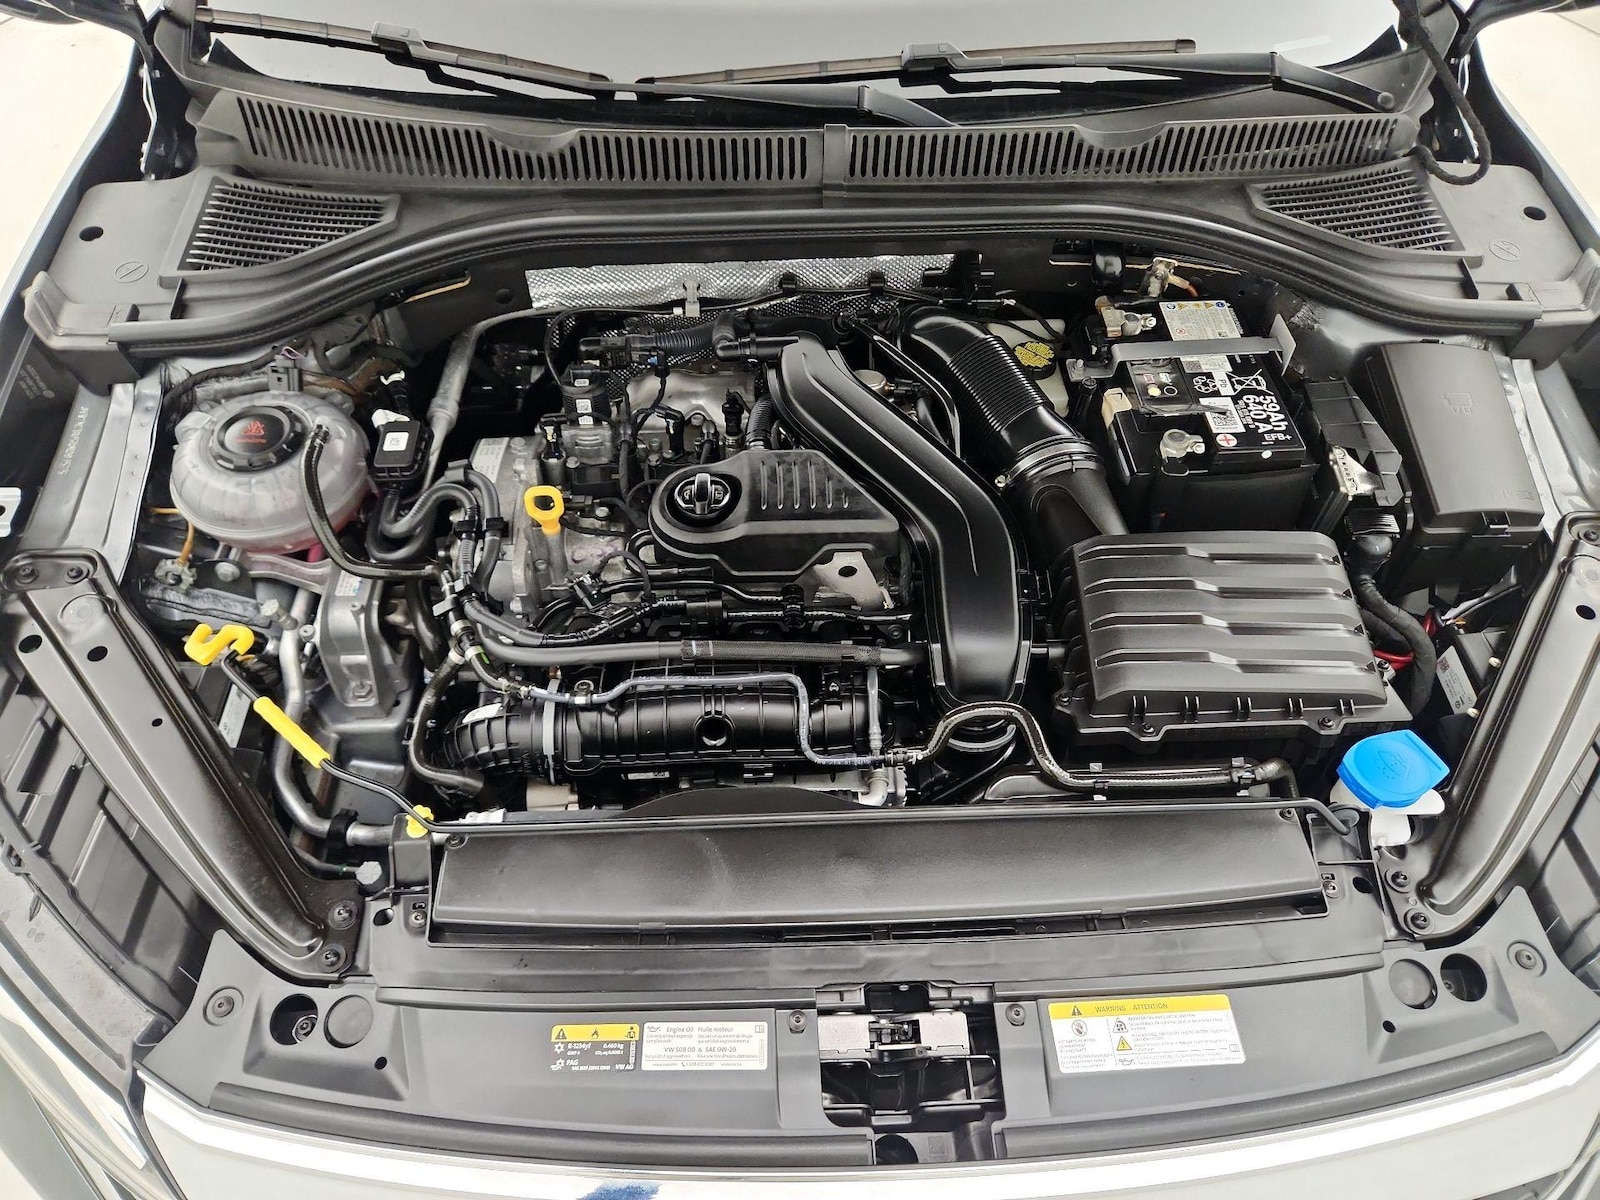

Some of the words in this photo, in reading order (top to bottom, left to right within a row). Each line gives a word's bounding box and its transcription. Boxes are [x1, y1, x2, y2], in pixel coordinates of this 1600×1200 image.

[1219, 379, 1228, 388] Pb
[1242, 394, 1268, 420] 640
[1259, 395, 1288, 431] 59Ah
[1253, 422, 1274, 434] A
[1263, 433, 1292, 441] EFB+
[1094, 1005, 1126, 1013] WARNING
[1133, 1002, 1168, 1011] ATTENTION
[666, 1026, 685, 1034] Engine
